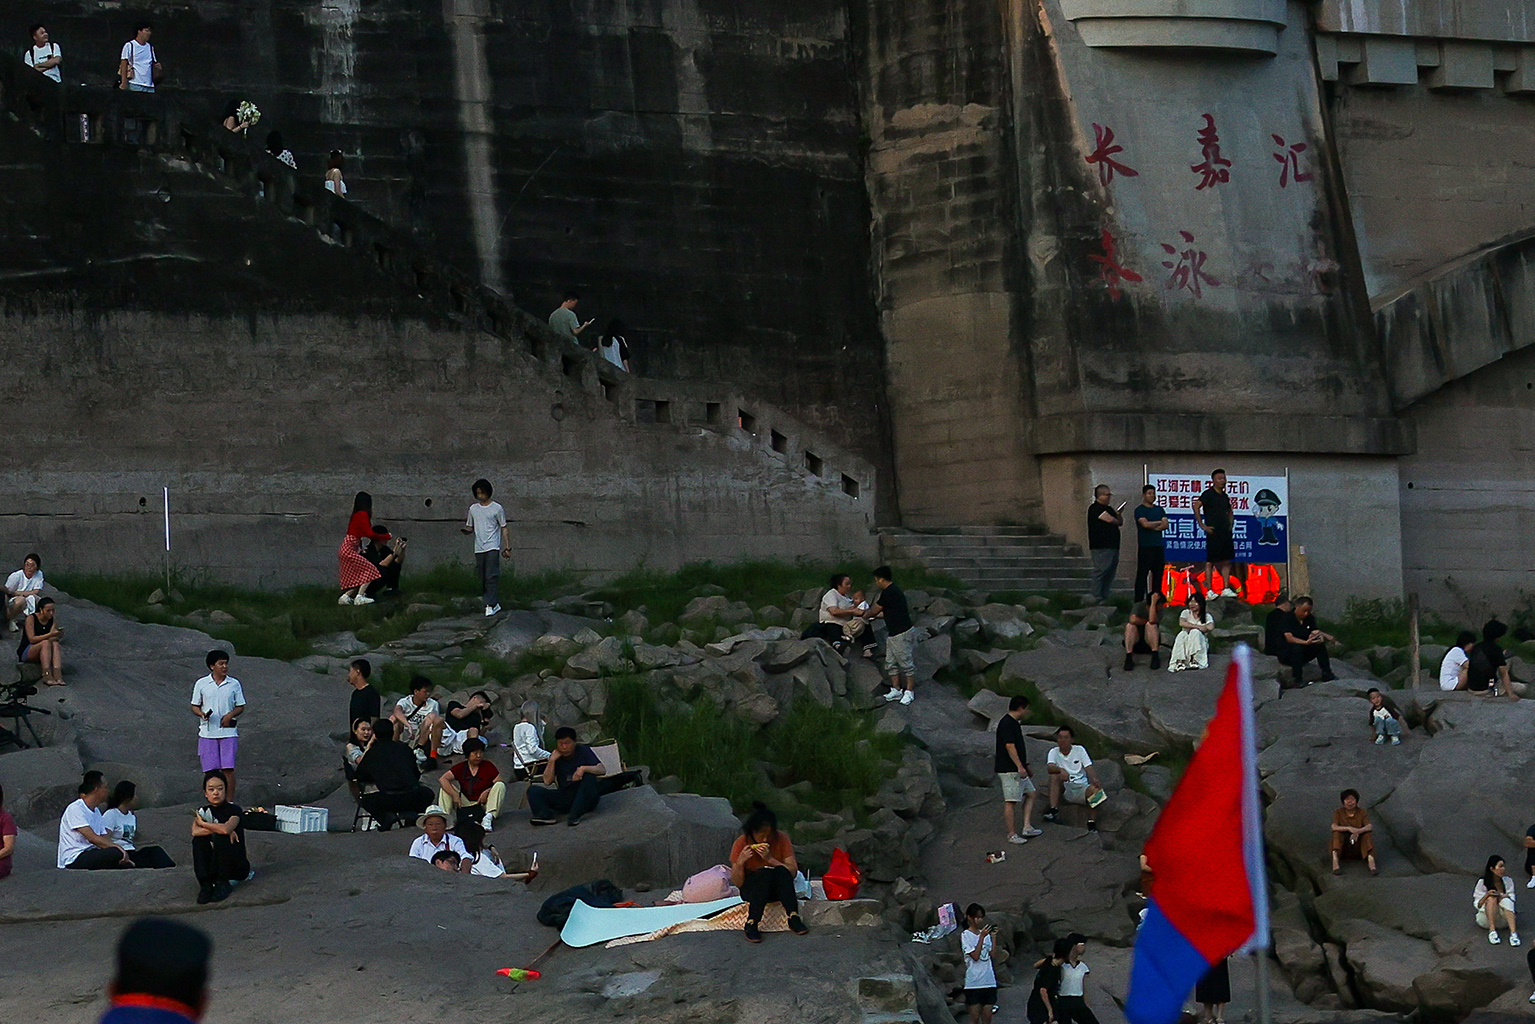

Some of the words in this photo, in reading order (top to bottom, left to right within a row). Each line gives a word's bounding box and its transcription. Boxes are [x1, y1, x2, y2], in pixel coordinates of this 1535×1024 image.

[1085, 113, 1314, 190] 长嘉汇
[1157, 479, 1202, 492] 江河无情
